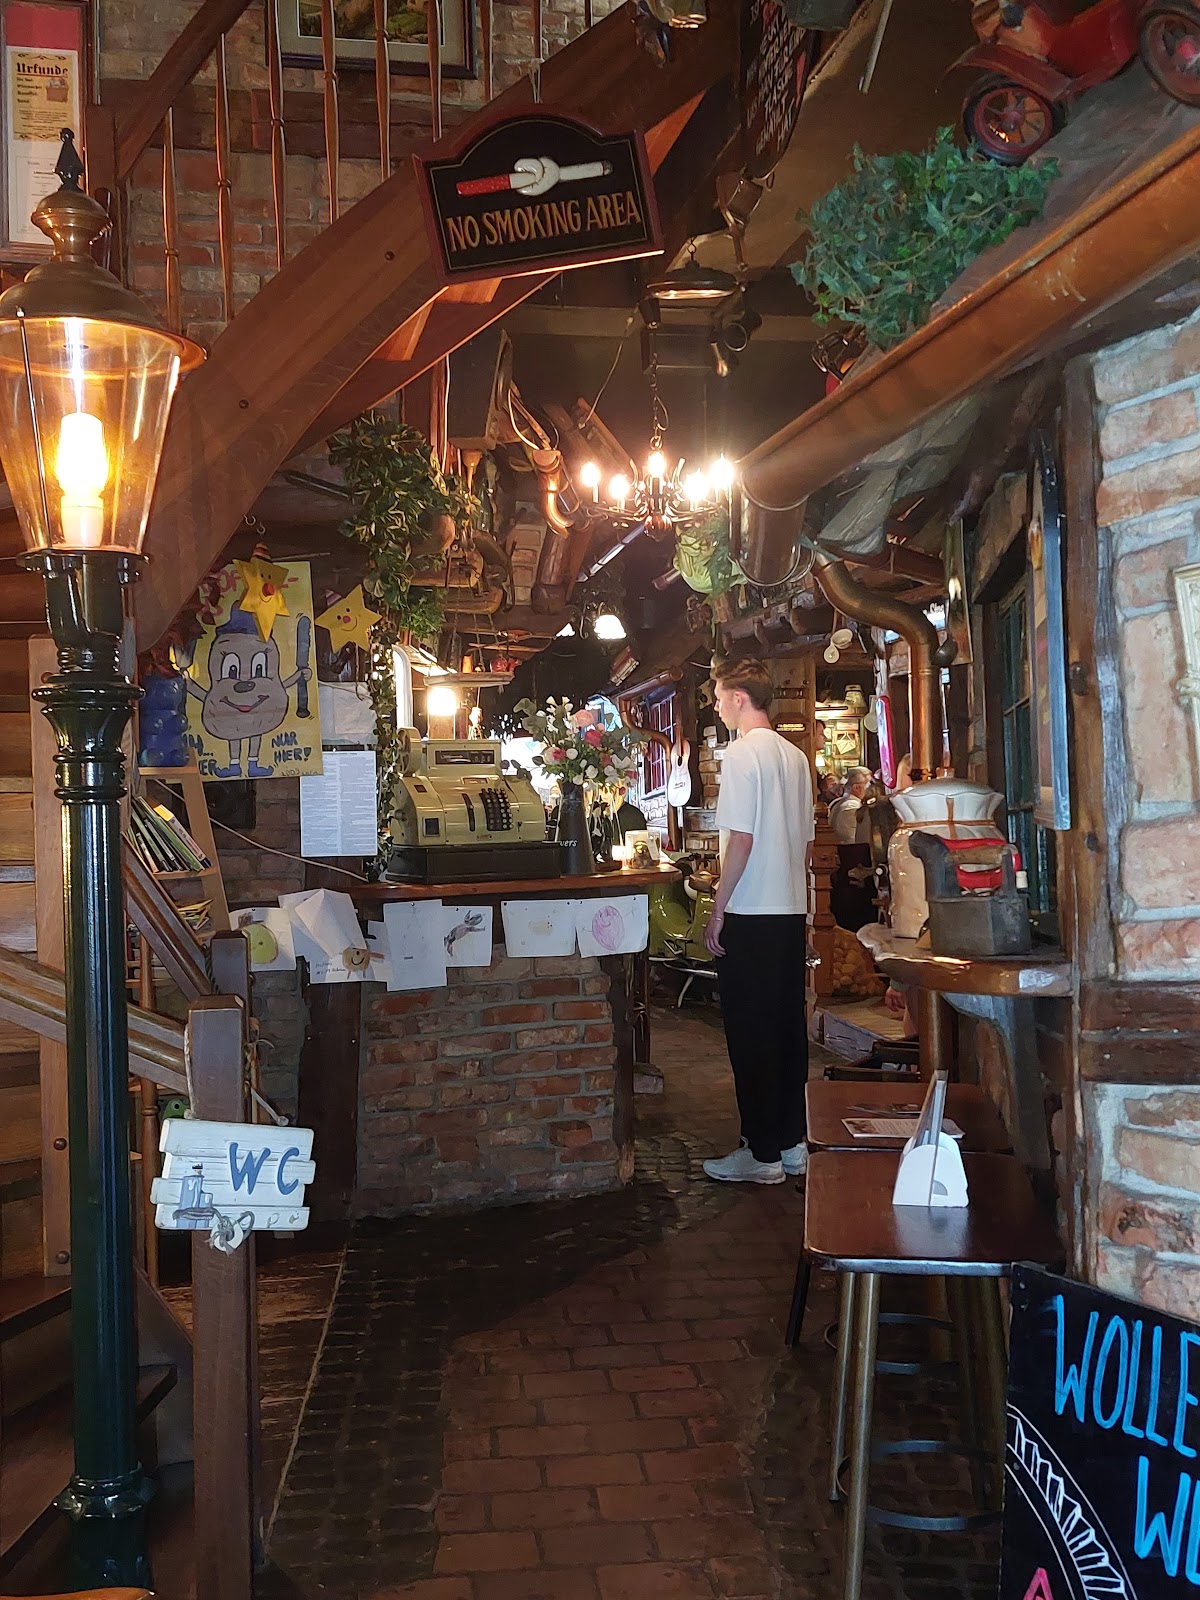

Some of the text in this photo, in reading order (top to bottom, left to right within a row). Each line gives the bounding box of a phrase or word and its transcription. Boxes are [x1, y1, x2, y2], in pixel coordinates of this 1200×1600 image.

[447, 191, 642, 252] NO SMOKING AREA
[271, 731, 298, 748] NUR
[274, 747, 311, 762] HIER!
[229, 1142, 300, 1196] WC
